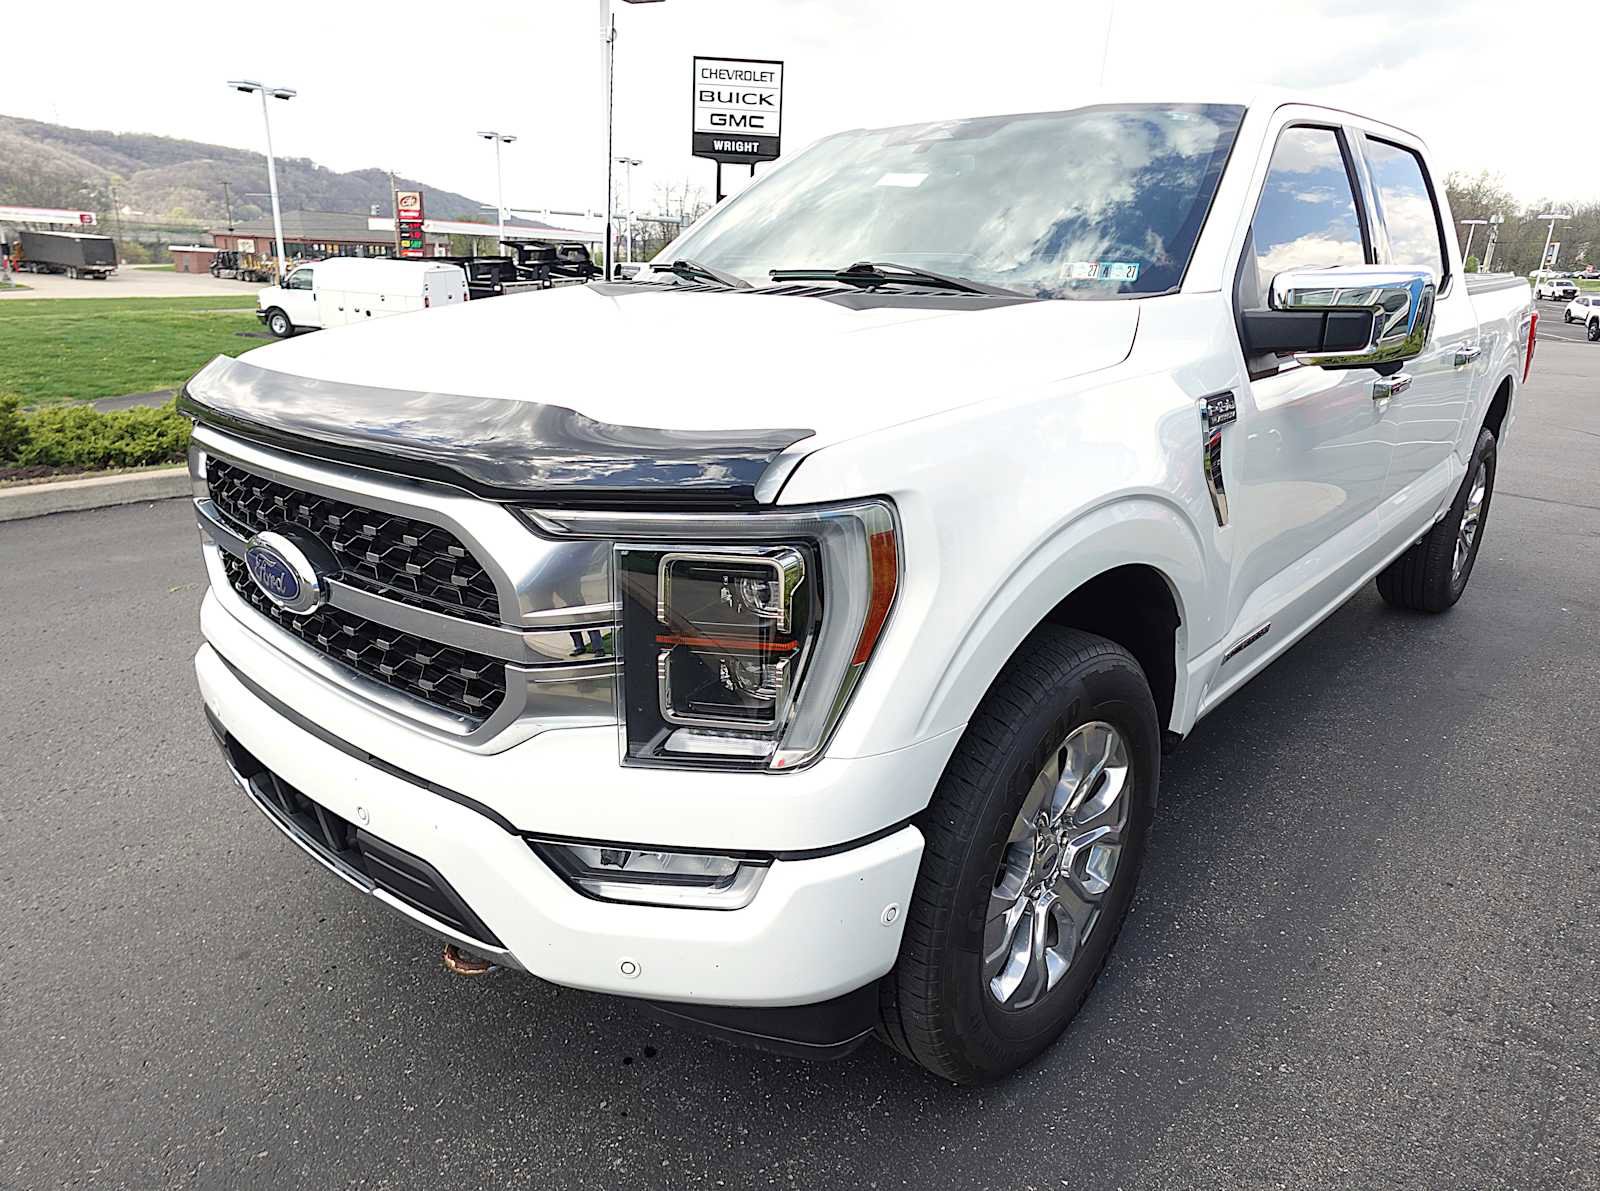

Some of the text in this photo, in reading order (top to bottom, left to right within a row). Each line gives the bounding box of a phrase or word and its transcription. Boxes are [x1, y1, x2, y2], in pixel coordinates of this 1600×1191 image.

[701, 68, 776, 82] CHEVROLET
[699, 90, 775, 106] BUICK
[710, 113, 764, 128] GMC
[713, 140, 760, 152] WRIGHT
[1087, 264, 1098, 277] 27
[1126, 265, 1137, 279] 27
[254, 553, 287, 594] Ford
